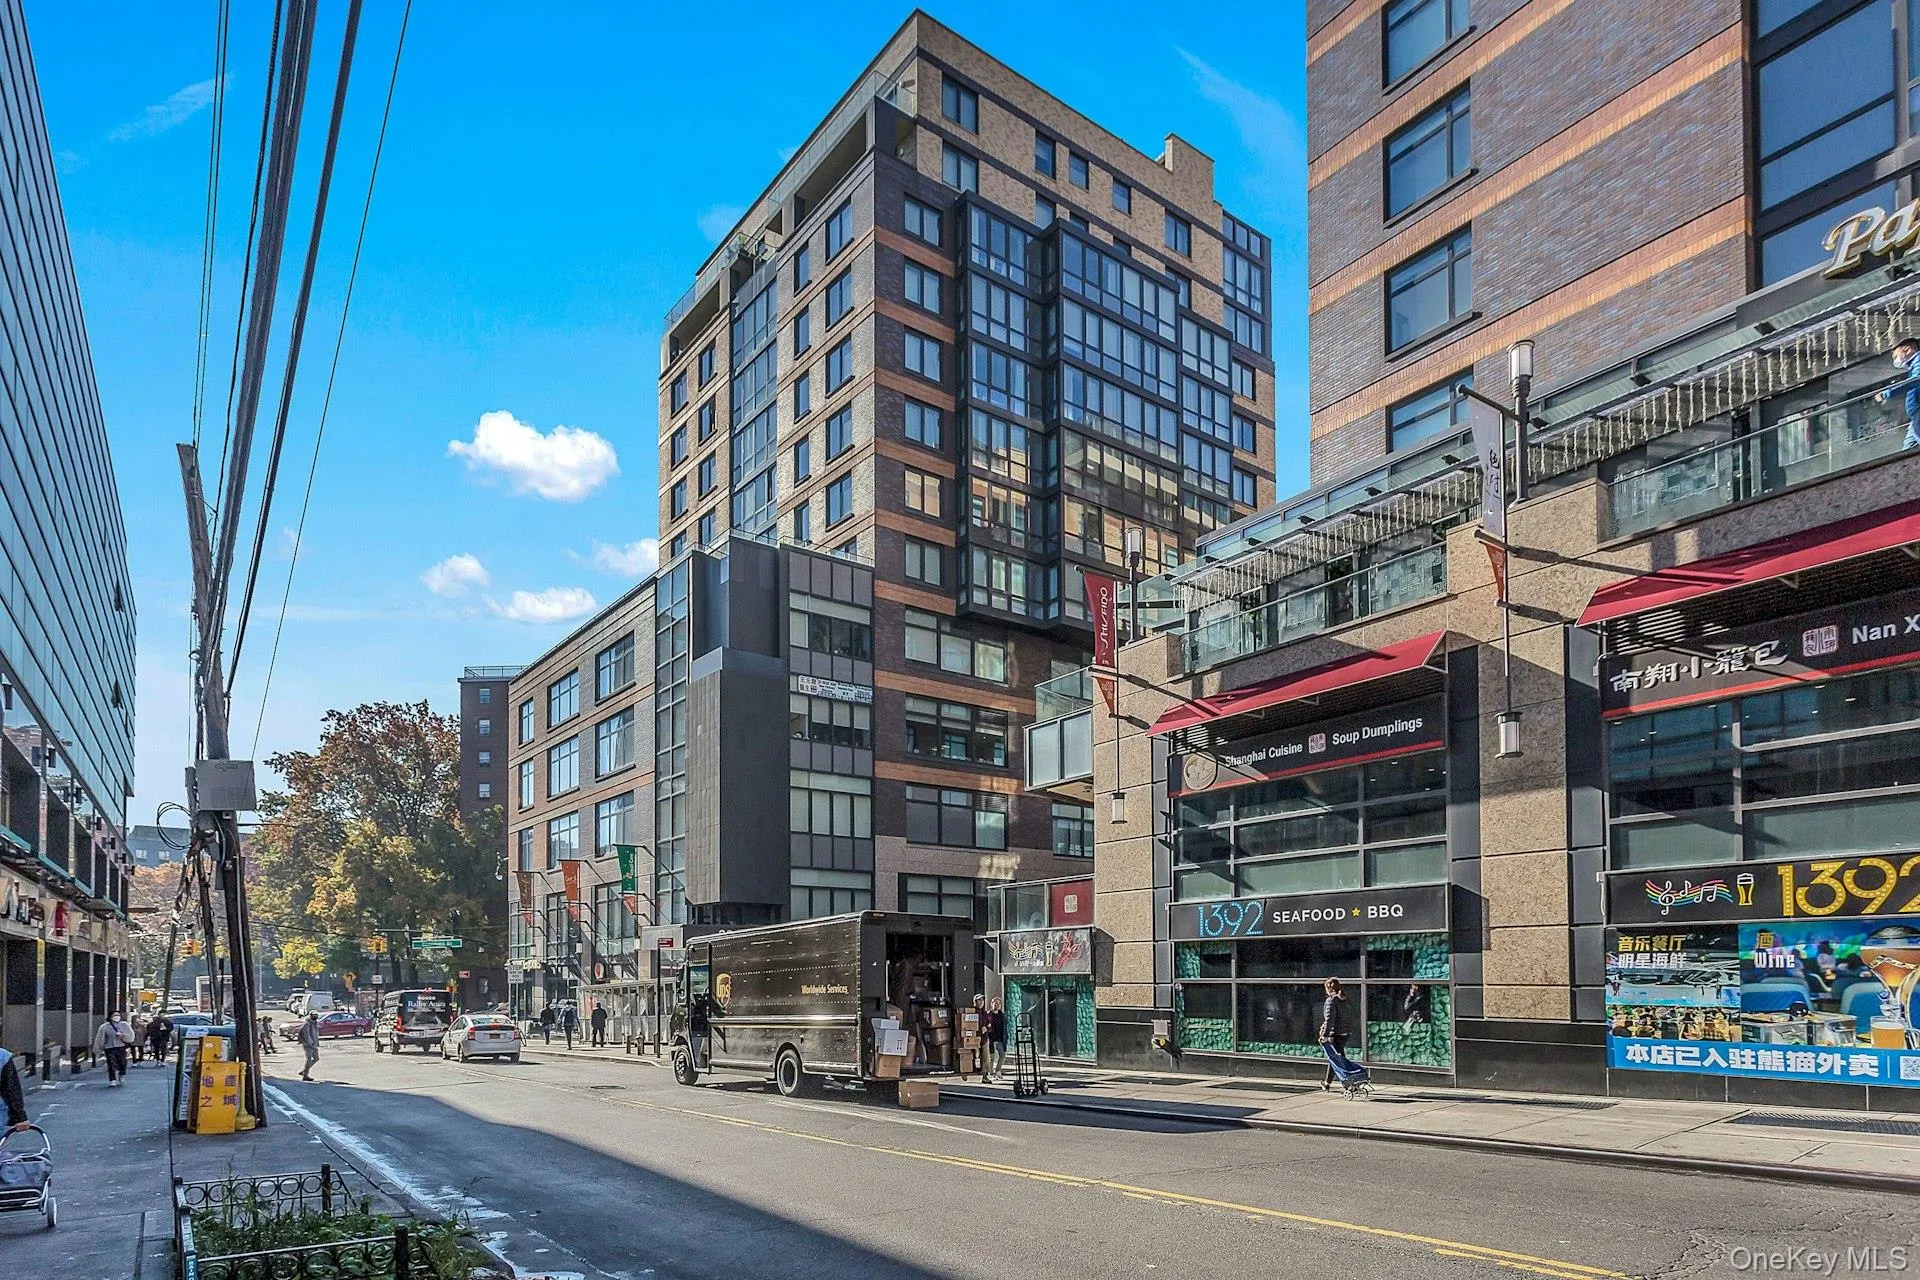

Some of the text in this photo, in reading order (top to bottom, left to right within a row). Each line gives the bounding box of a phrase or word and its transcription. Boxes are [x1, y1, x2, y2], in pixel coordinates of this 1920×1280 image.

[1852, 622, 1896, 645] Nan
[1332, 730, 1360, 748] Soup
[1362, 717, 1423, 740] Dumplings
[1225, 749, 1266, 767] Shanghai
[1268, 743, 1303, 759] Cuisine
[1197, 901, 1264, 938] 1392
[1272, 904, 1404, 923] SEAFOOD BBQ
[1618, 934, 1686, 952] 音乐餐厅
[1755, 932, 1774, 949] 酒
[1753, 951, 1795, 969] Wine
[717, 984, 730, 1001] ups
[801, 983, 848, 995] Worldwide Services
[1626, 1043, 1879, 1077] 本店已入驻熊猫外卖
